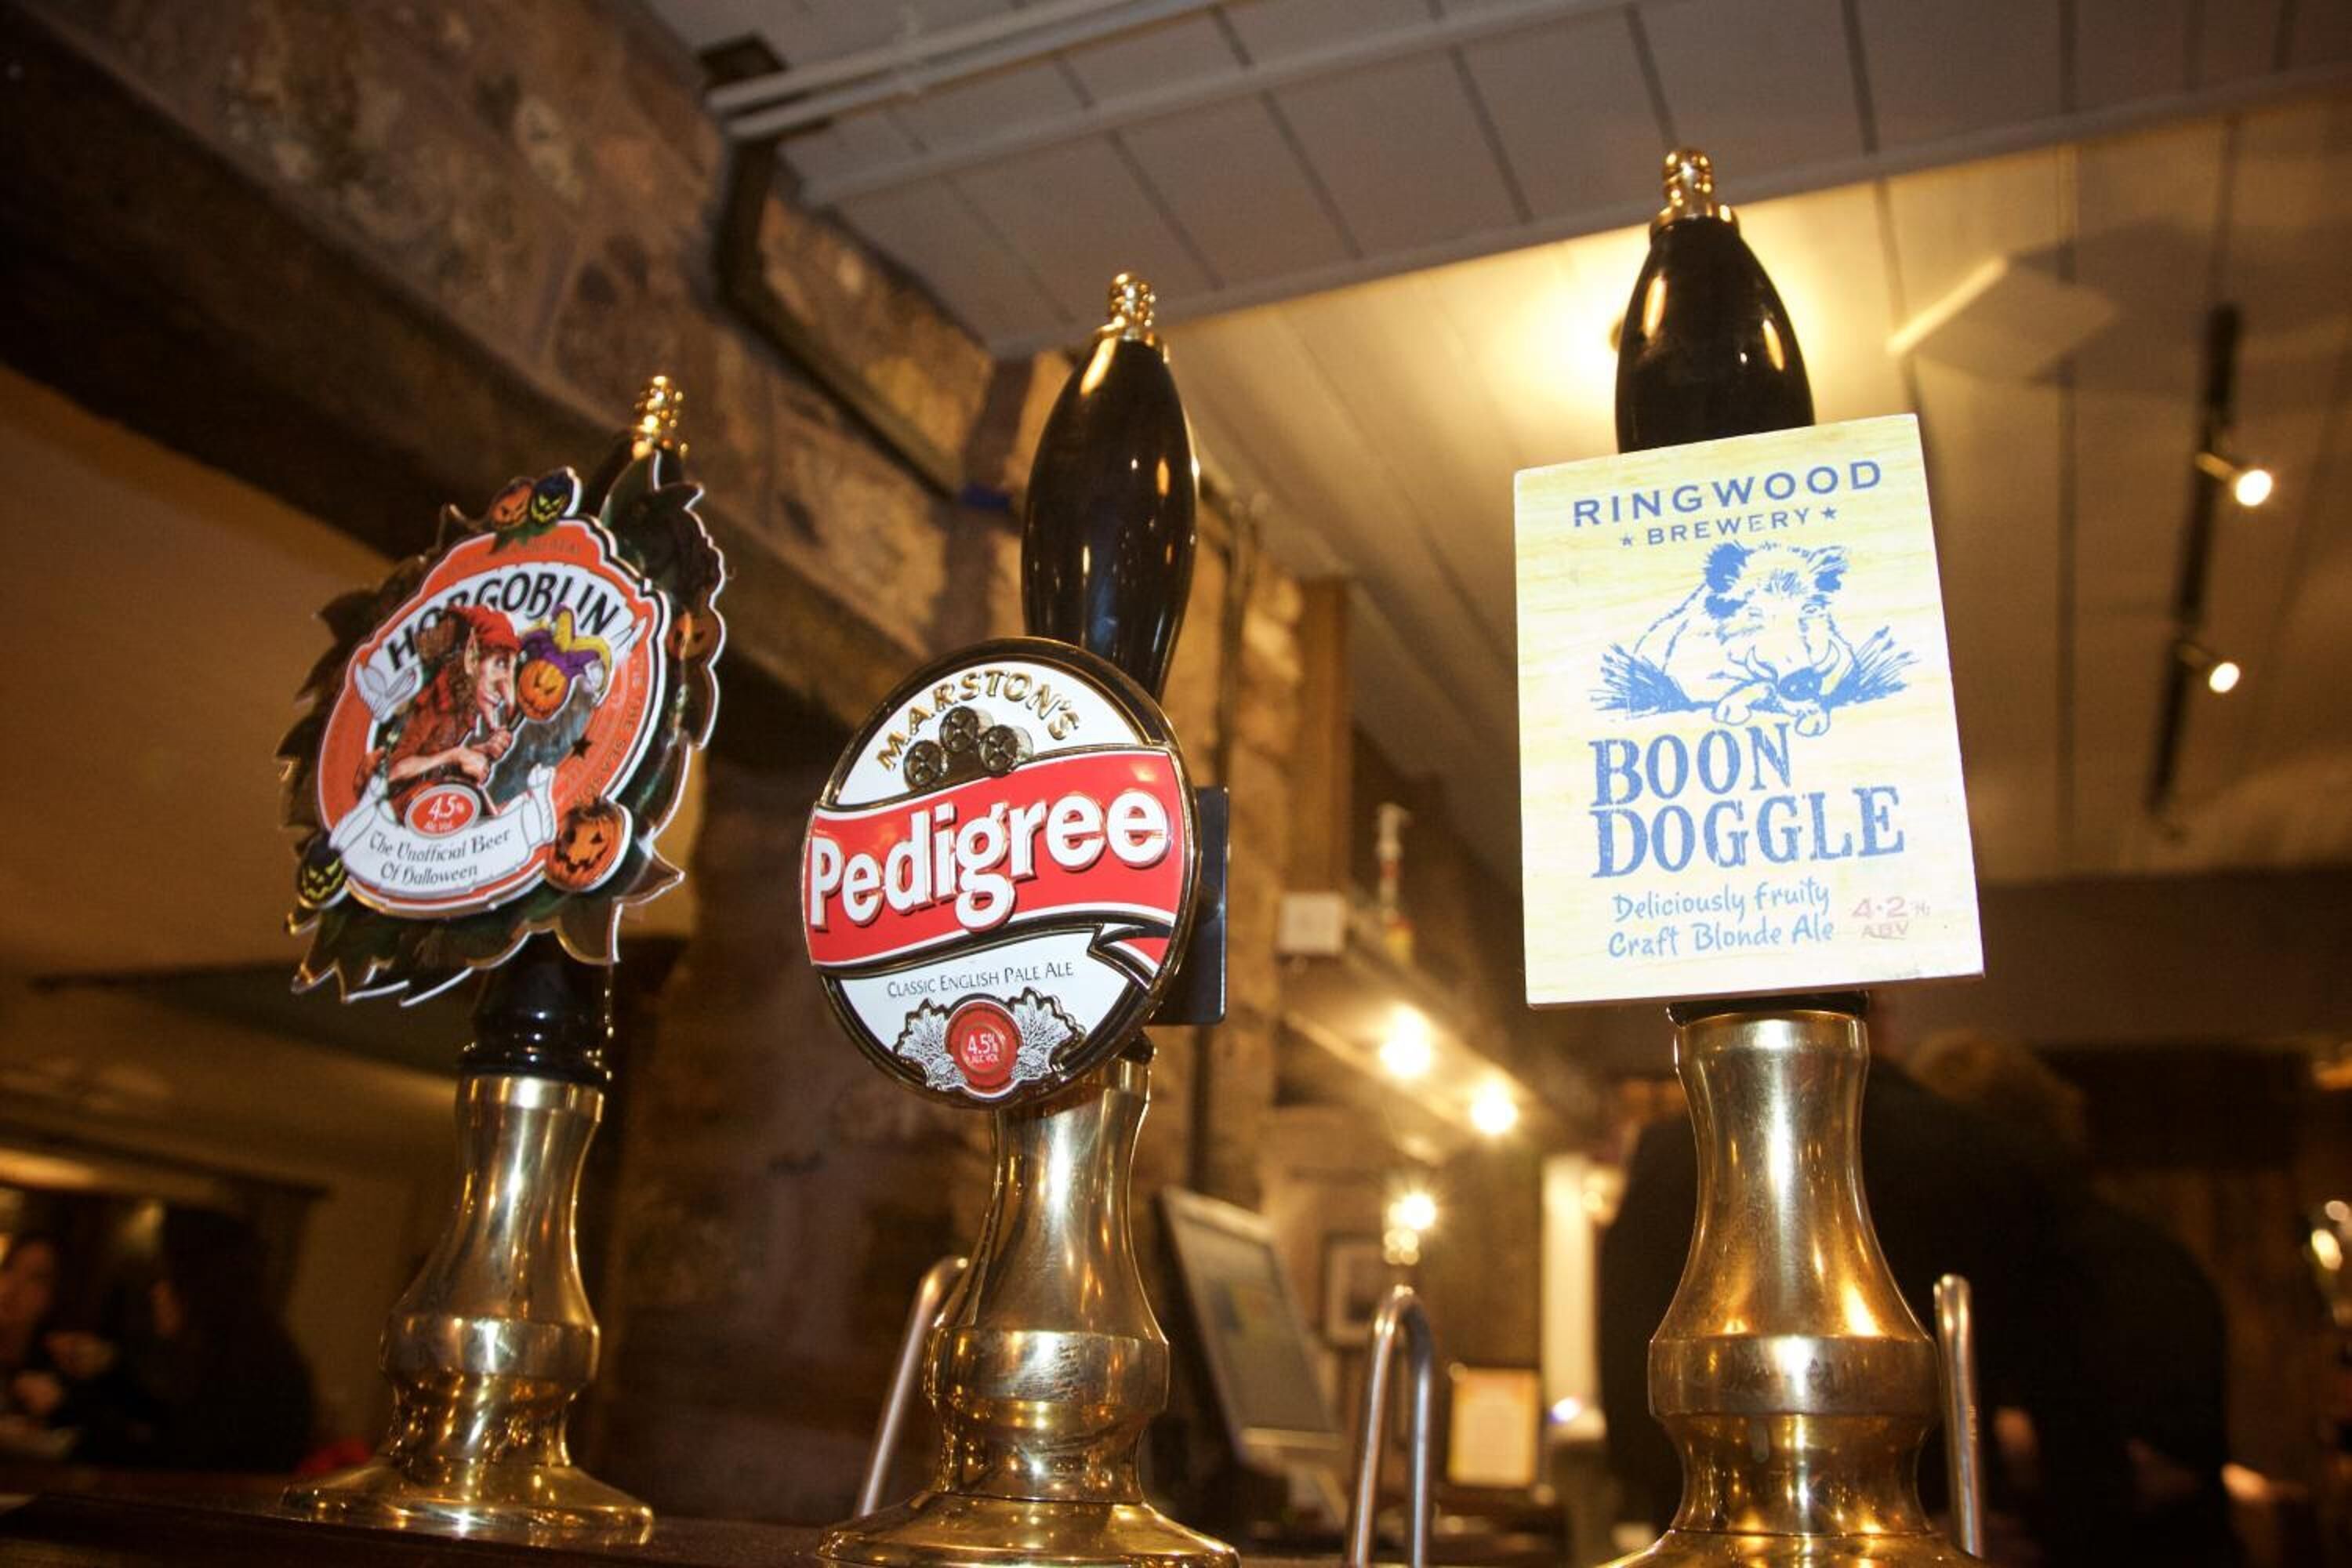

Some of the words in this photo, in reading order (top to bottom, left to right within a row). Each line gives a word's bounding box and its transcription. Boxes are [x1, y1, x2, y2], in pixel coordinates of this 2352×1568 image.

[1573, 460, 1882, 527] RINGWOOD
[1646, 506, 1810, 546] BREWERY
[877, 668, 1080, 771] MARSTON'S
[1588, 723, 1791, 807] BOON
[369, 829, 393, 855] The
[397, 839, 466, 863] Unofficial
[471, 829, 510, 854] Beer
[1589, 786, 1905, 878] DOGGLE
[380, 861, 398, 880] Of
[401, 866, 477, 887] Halloween
[810, 789, 1171, 931] Pedigree
[1612, 884, 1746, 923] Deliciously
[1754, 876, 1830, 916] fruity
[1608, 925, 1680, 958] Craft
[1691, 920, 1782, 952] Blonde
[1791, 913, 1835, 942] Ale
[887, 979, 937, 998] CLASSIC
[941, 971, 1000, 992] ENGLISH
[1004, 965, 1041, 984] PALE
[1045, 961, 1075, 979] ALE
